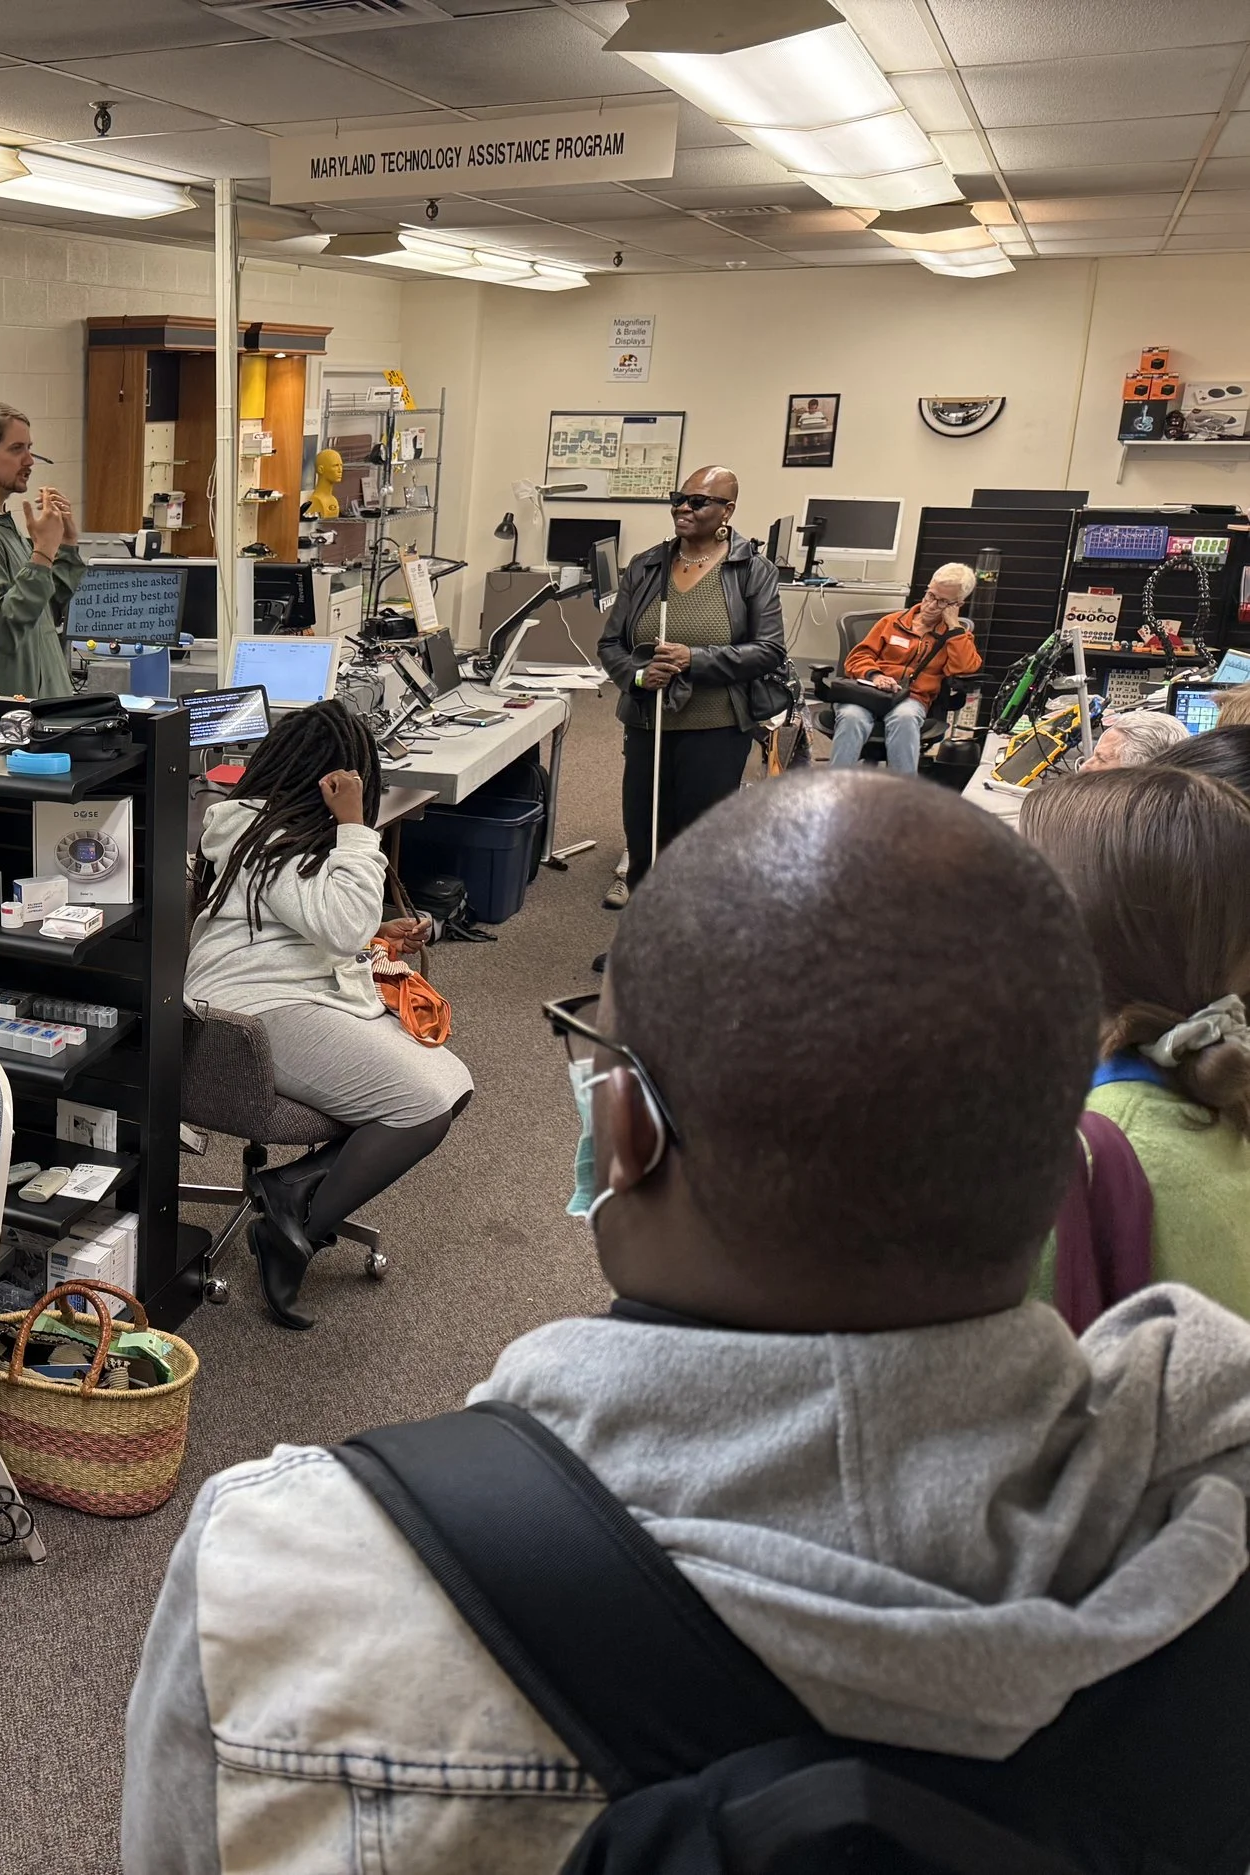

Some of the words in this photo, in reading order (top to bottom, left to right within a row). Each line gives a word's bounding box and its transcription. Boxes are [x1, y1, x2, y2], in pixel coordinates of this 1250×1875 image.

[310, 153, 376, 179] MARYLAND
[381, 146, 462, 174] TECHNOLOGY
[467, 138, 550, 166] ASSISTANCE
[555, 132, 625, 160] PROGRAM
[613, 318, 651, 328] Magnifiers
[615, 338, 646, 346] Displays
[131, 578, 150, 588] she
[150, 575, 178, 586] asked
[75, 595, 92, 606] and
[96, 594, 101, 604] I
[103, 593, 119, 604] did
[122, 594, 138, 604] my
[140, 591, 160, 601] best
[163, 590, 180, 600] too
[86, 608, 106, 619] One
[111, 606, 144, 617] Friday
[148, 603, 175, 616] night
[75, 623, 89, 633] for
[91, 621, 124, 632] dinner
[127, 621, 137, 630] at
[139, 620, 156, 630] my
